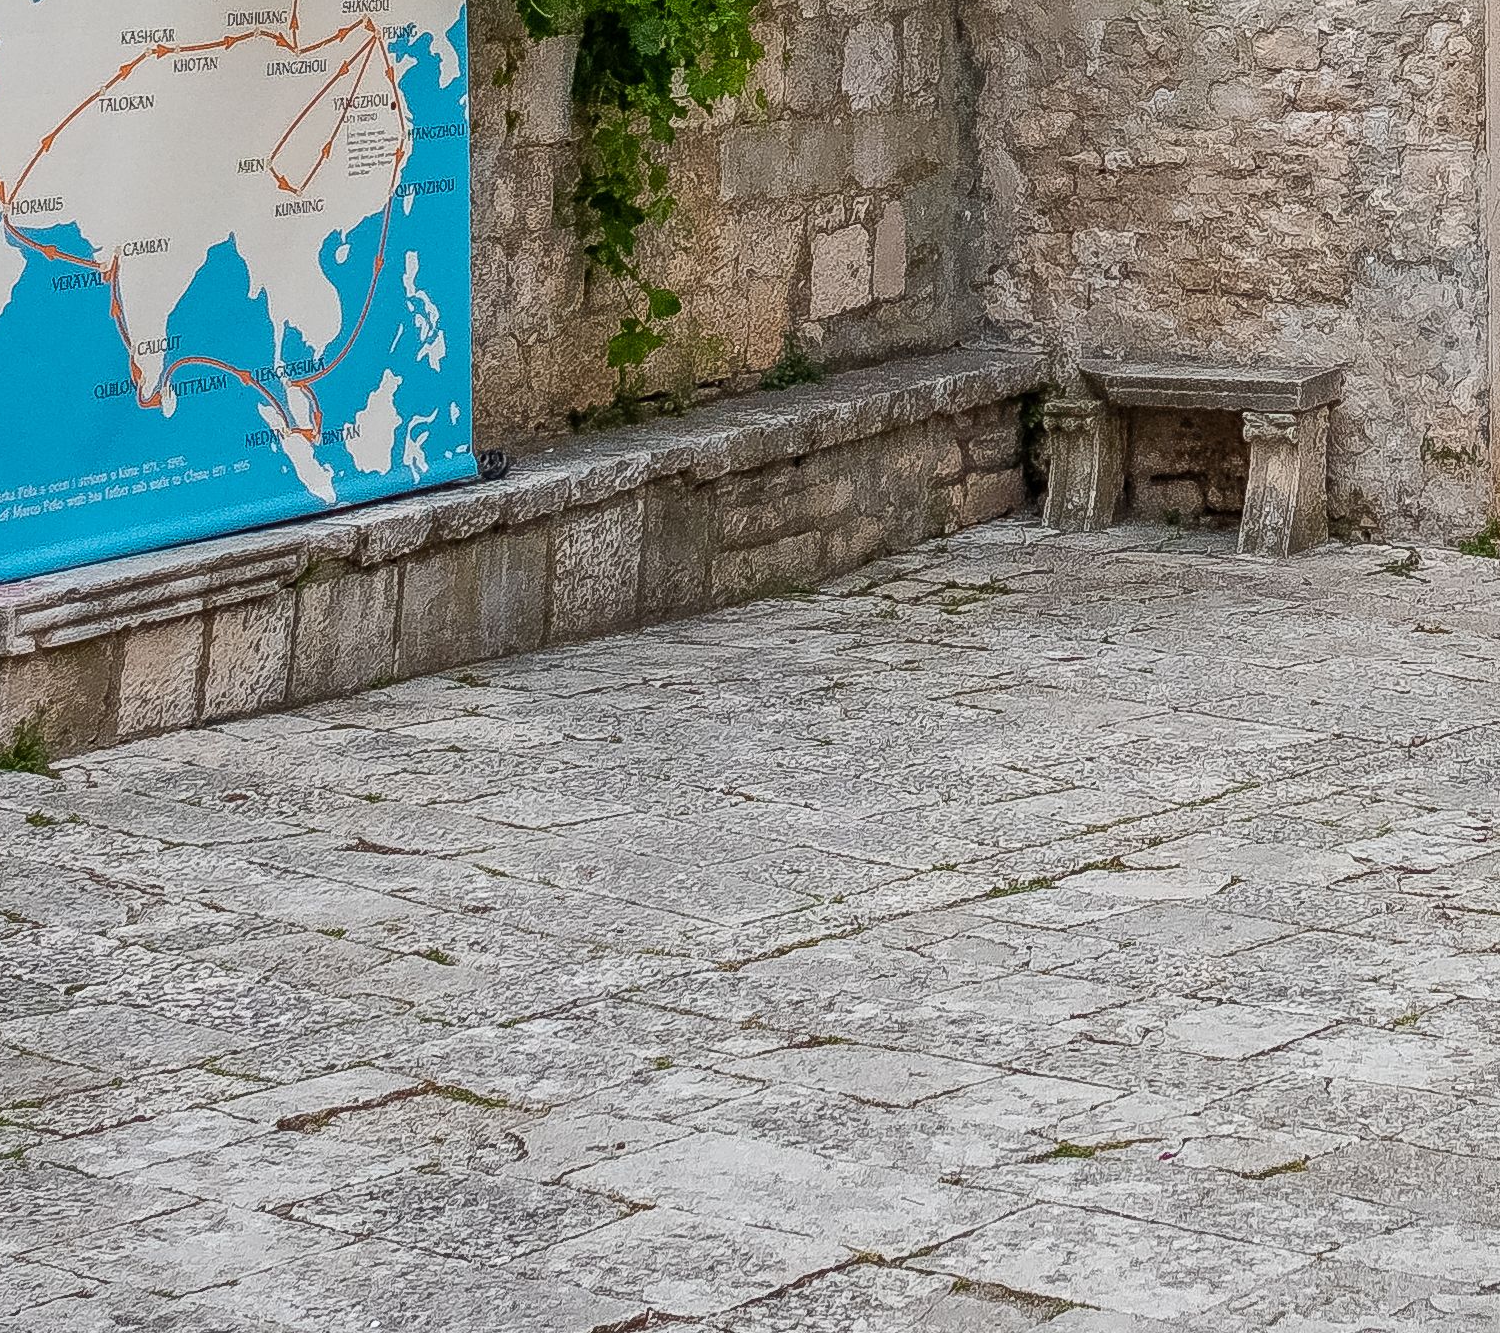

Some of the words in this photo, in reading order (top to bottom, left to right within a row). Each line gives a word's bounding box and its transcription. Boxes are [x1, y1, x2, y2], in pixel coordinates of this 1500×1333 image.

[342, 0, 390, 14] SHANGDU
[121, 29, 175, 45] KASHGAR
[383, 25, 418, 39] PEKING
[173, 57, 219, 73] KHOTAN
[99, 96, 155, 113] TALOKAN
[333, 94, 389, 110] YANGZHOU
[408, 123, 466, 141] HANGZHOU
[11, 197, 64, 215] HORMUS
[275, 199, 324, 218] KUNMING
[123, 238, 170, 256] CAMBAY
[52, 271, 104, 292] VERAVAL
